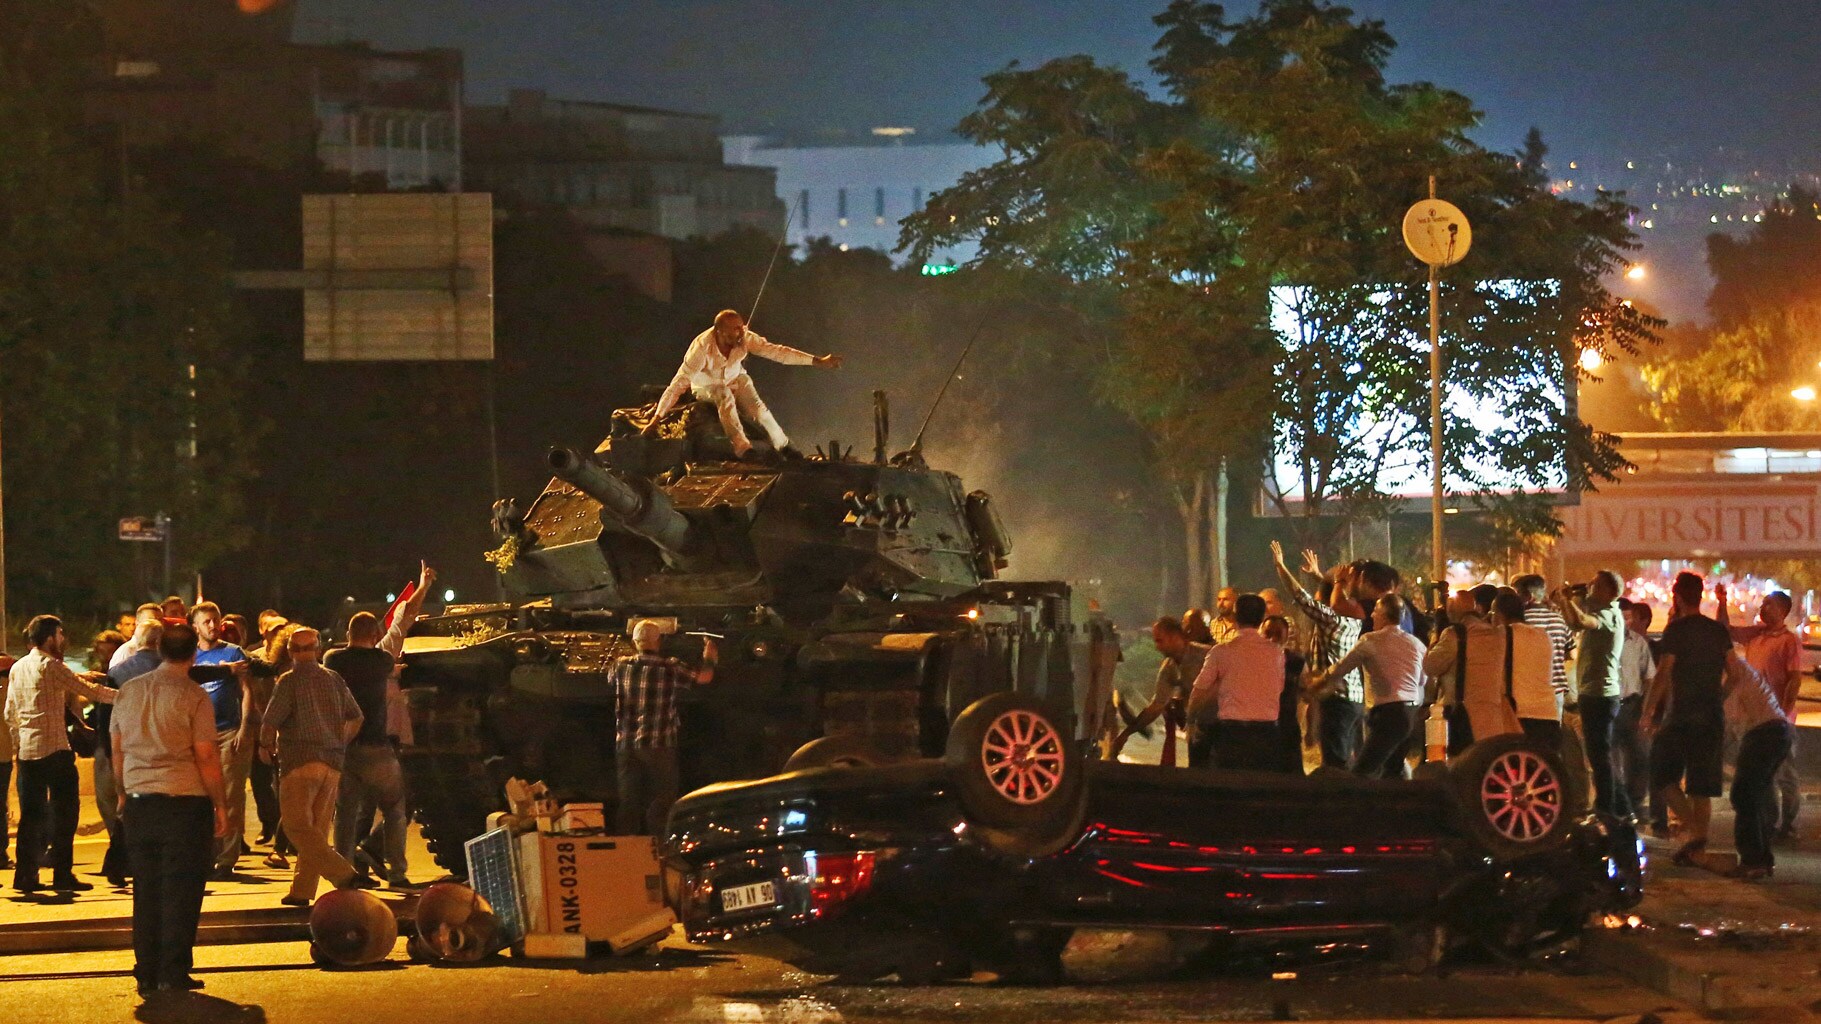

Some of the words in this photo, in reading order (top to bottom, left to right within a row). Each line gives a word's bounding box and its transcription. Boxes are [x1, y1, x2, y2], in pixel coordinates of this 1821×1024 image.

[1562, 498, 1816, 542] NİVERSİTESİ
[557, 842, 581, 933] ANK-0328
[761, 884, 774, 902] 06
